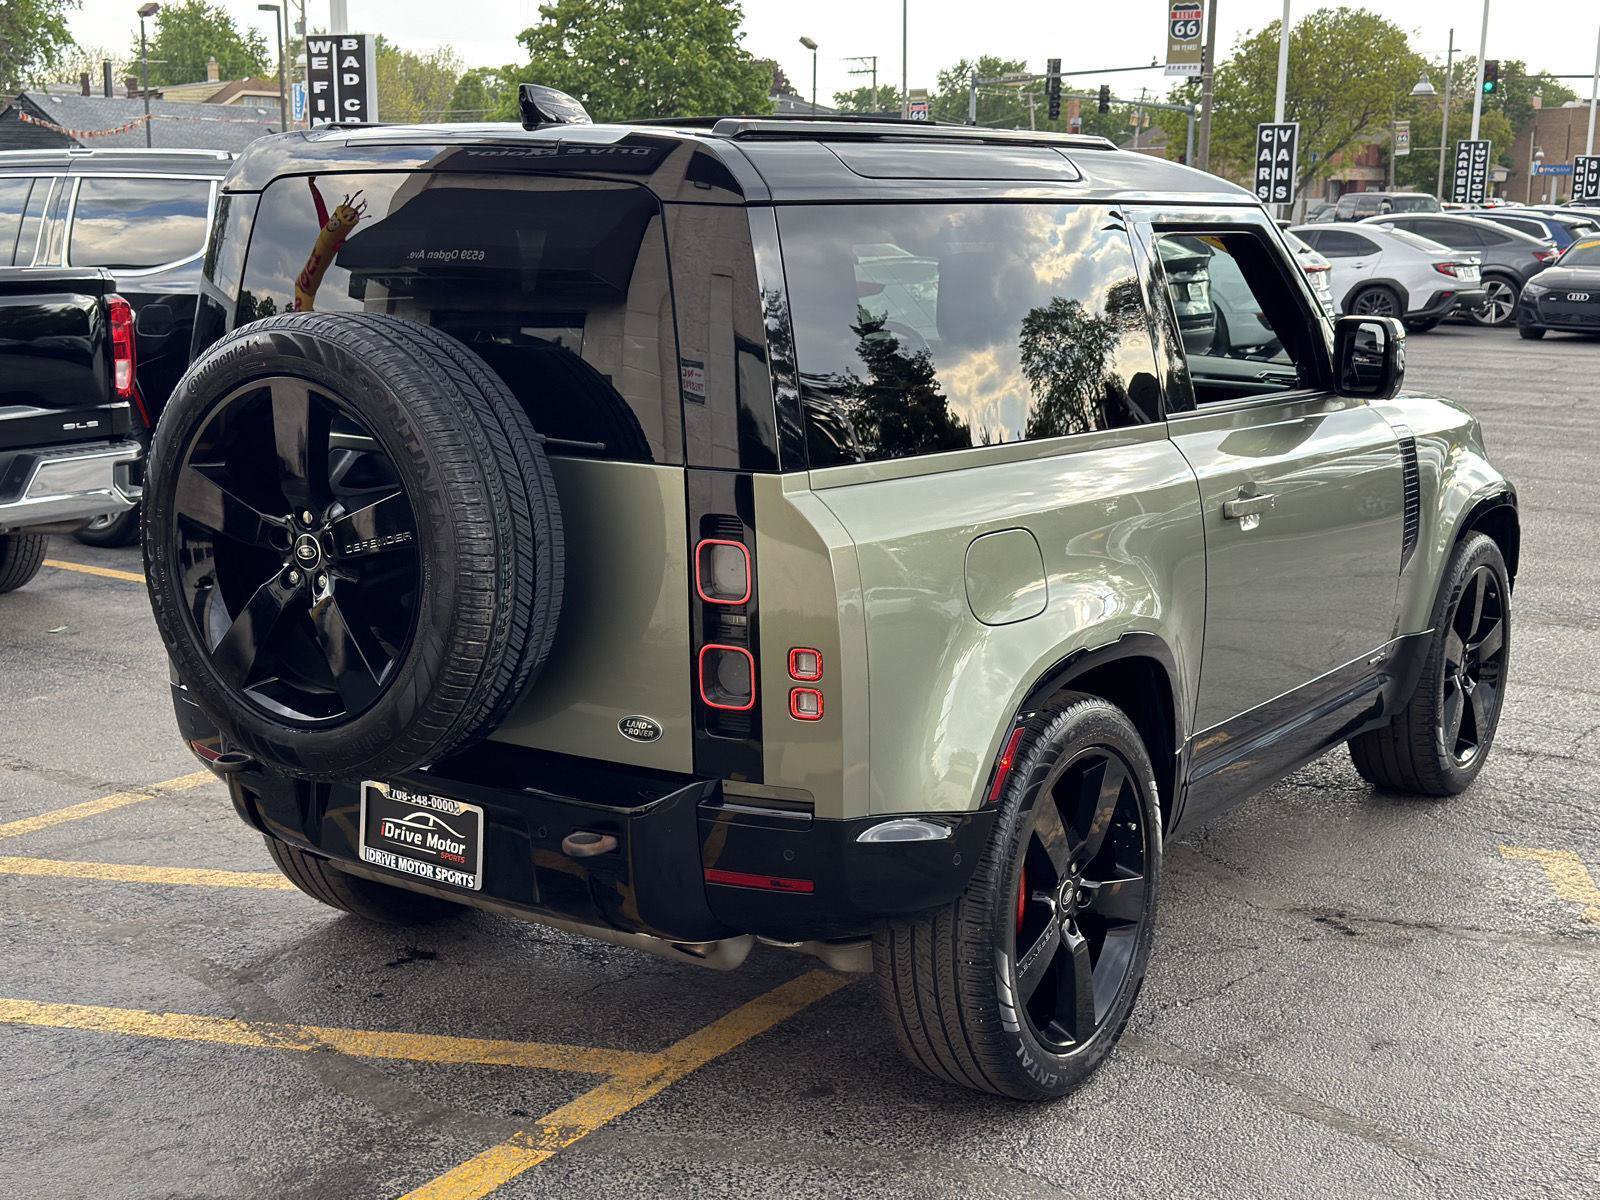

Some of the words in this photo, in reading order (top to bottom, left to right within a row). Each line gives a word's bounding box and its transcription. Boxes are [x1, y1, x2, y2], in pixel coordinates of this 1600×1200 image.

[1174, 20, 1197, 36] 66
[308, 40, 332, 70] WE
[341, 38, 360, 86] BAD
[911, 110, 925, 120] 66
[1258, 129, 1273, 199] CARS
[1275, 129, 1292, 199] VANS
[1455, 142, 1469, 203] LARGEST
[1587, 160, 1598, 195] SUV
[345, 531, 413, 554] DEFENDER
[380, 821, 422, 845] iDrive
[426, 832, 466, 855] Motor
[398, 857, 433, 878] MOTOR
[435, 867, 475, 888] SPORTS
[440, 851, 465, 864] SPORTS
